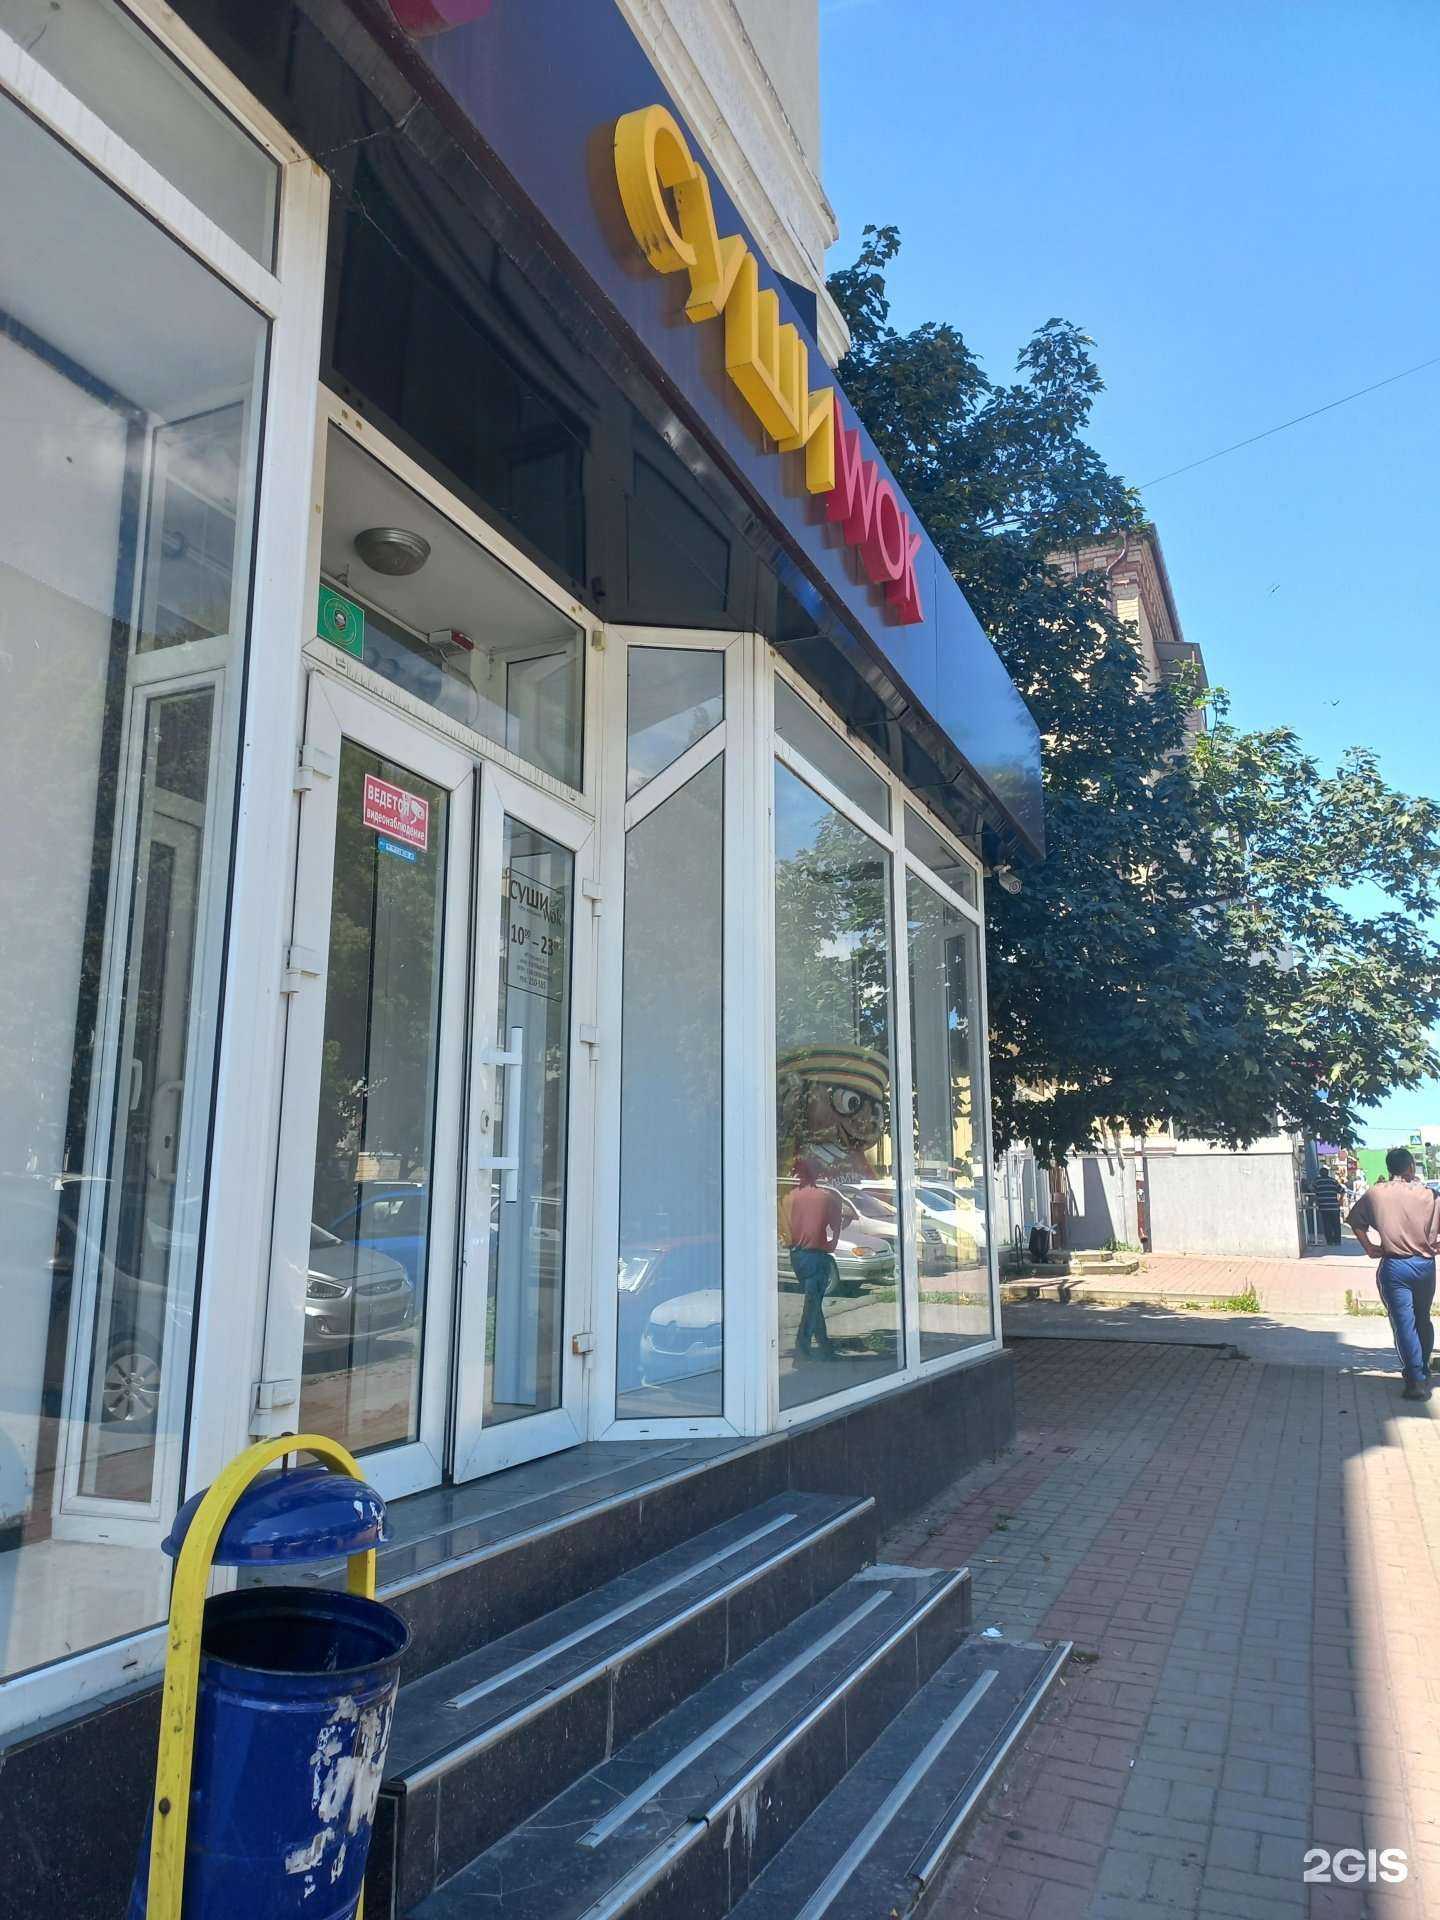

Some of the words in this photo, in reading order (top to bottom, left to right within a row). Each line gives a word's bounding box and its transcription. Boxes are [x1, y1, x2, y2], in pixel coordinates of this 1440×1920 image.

[614, 104, 836, 493] СУШИ
[826, 394, 924, 626] WOK
[509, 879, 550, 912] СУШИ
